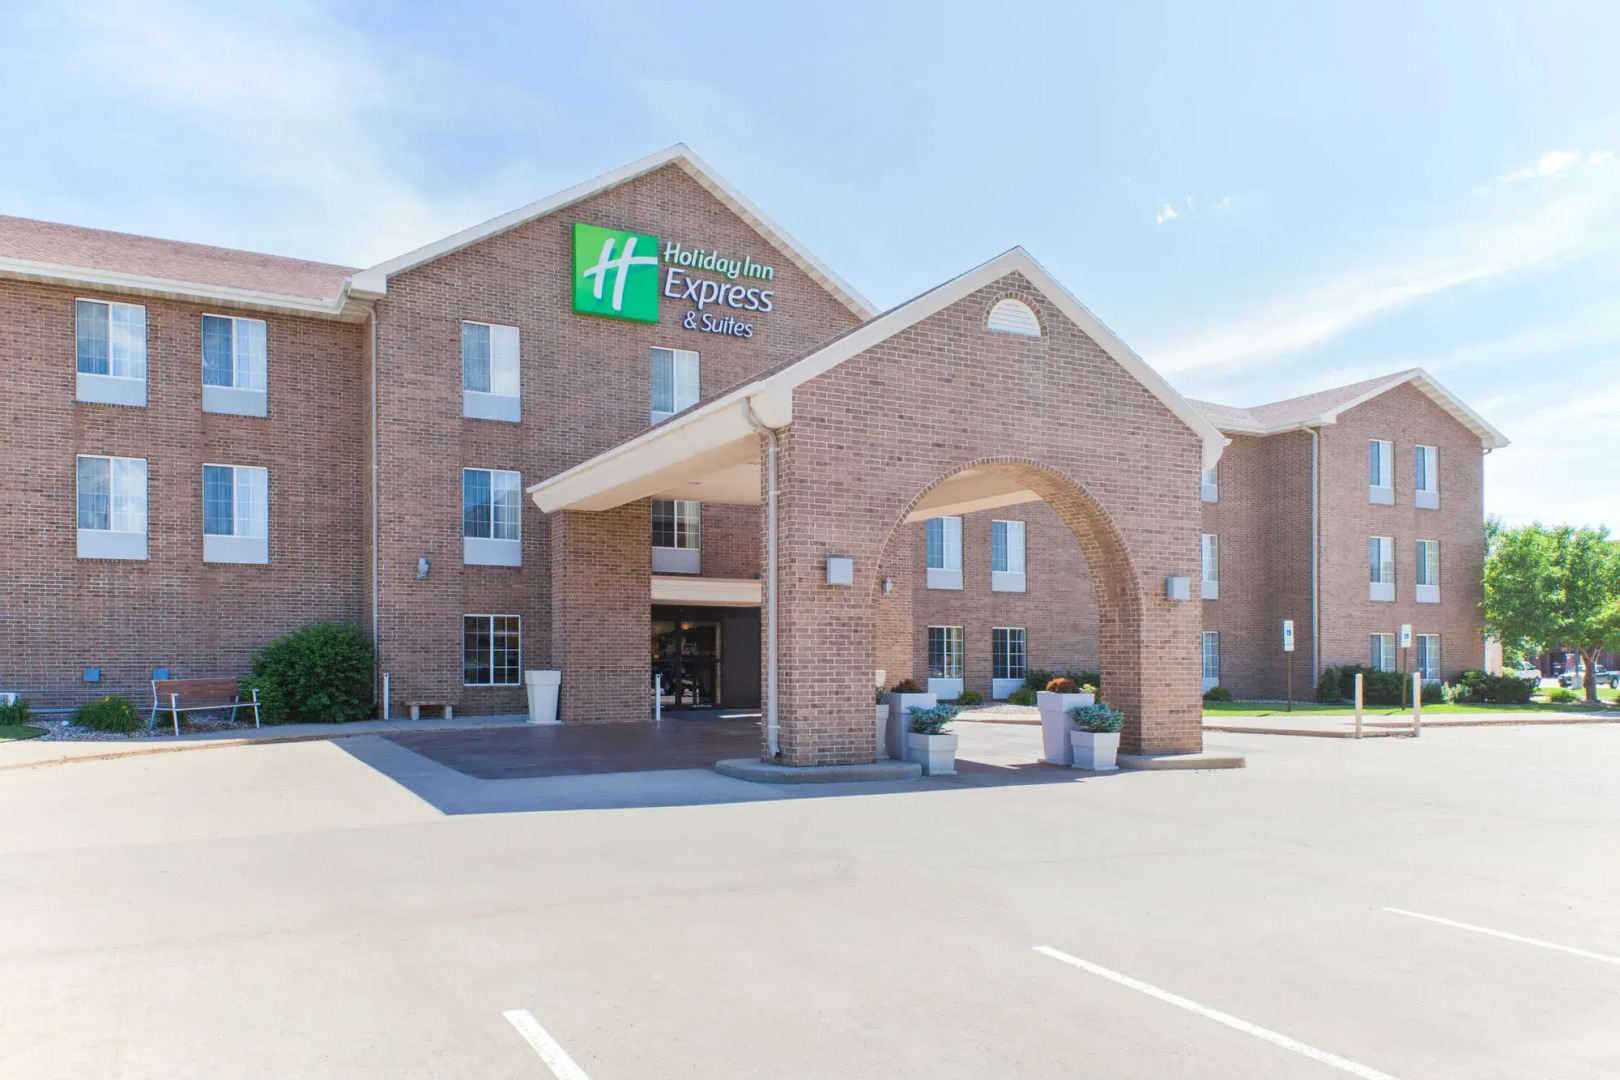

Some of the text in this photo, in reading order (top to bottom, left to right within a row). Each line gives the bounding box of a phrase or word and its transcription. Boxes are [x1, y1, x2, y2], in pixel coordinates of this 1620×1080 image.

[663, 241, 774, 281] Holiday Inn
[664, 267, 774, 313] Express
[683, 310, 753, 338] & Suites
